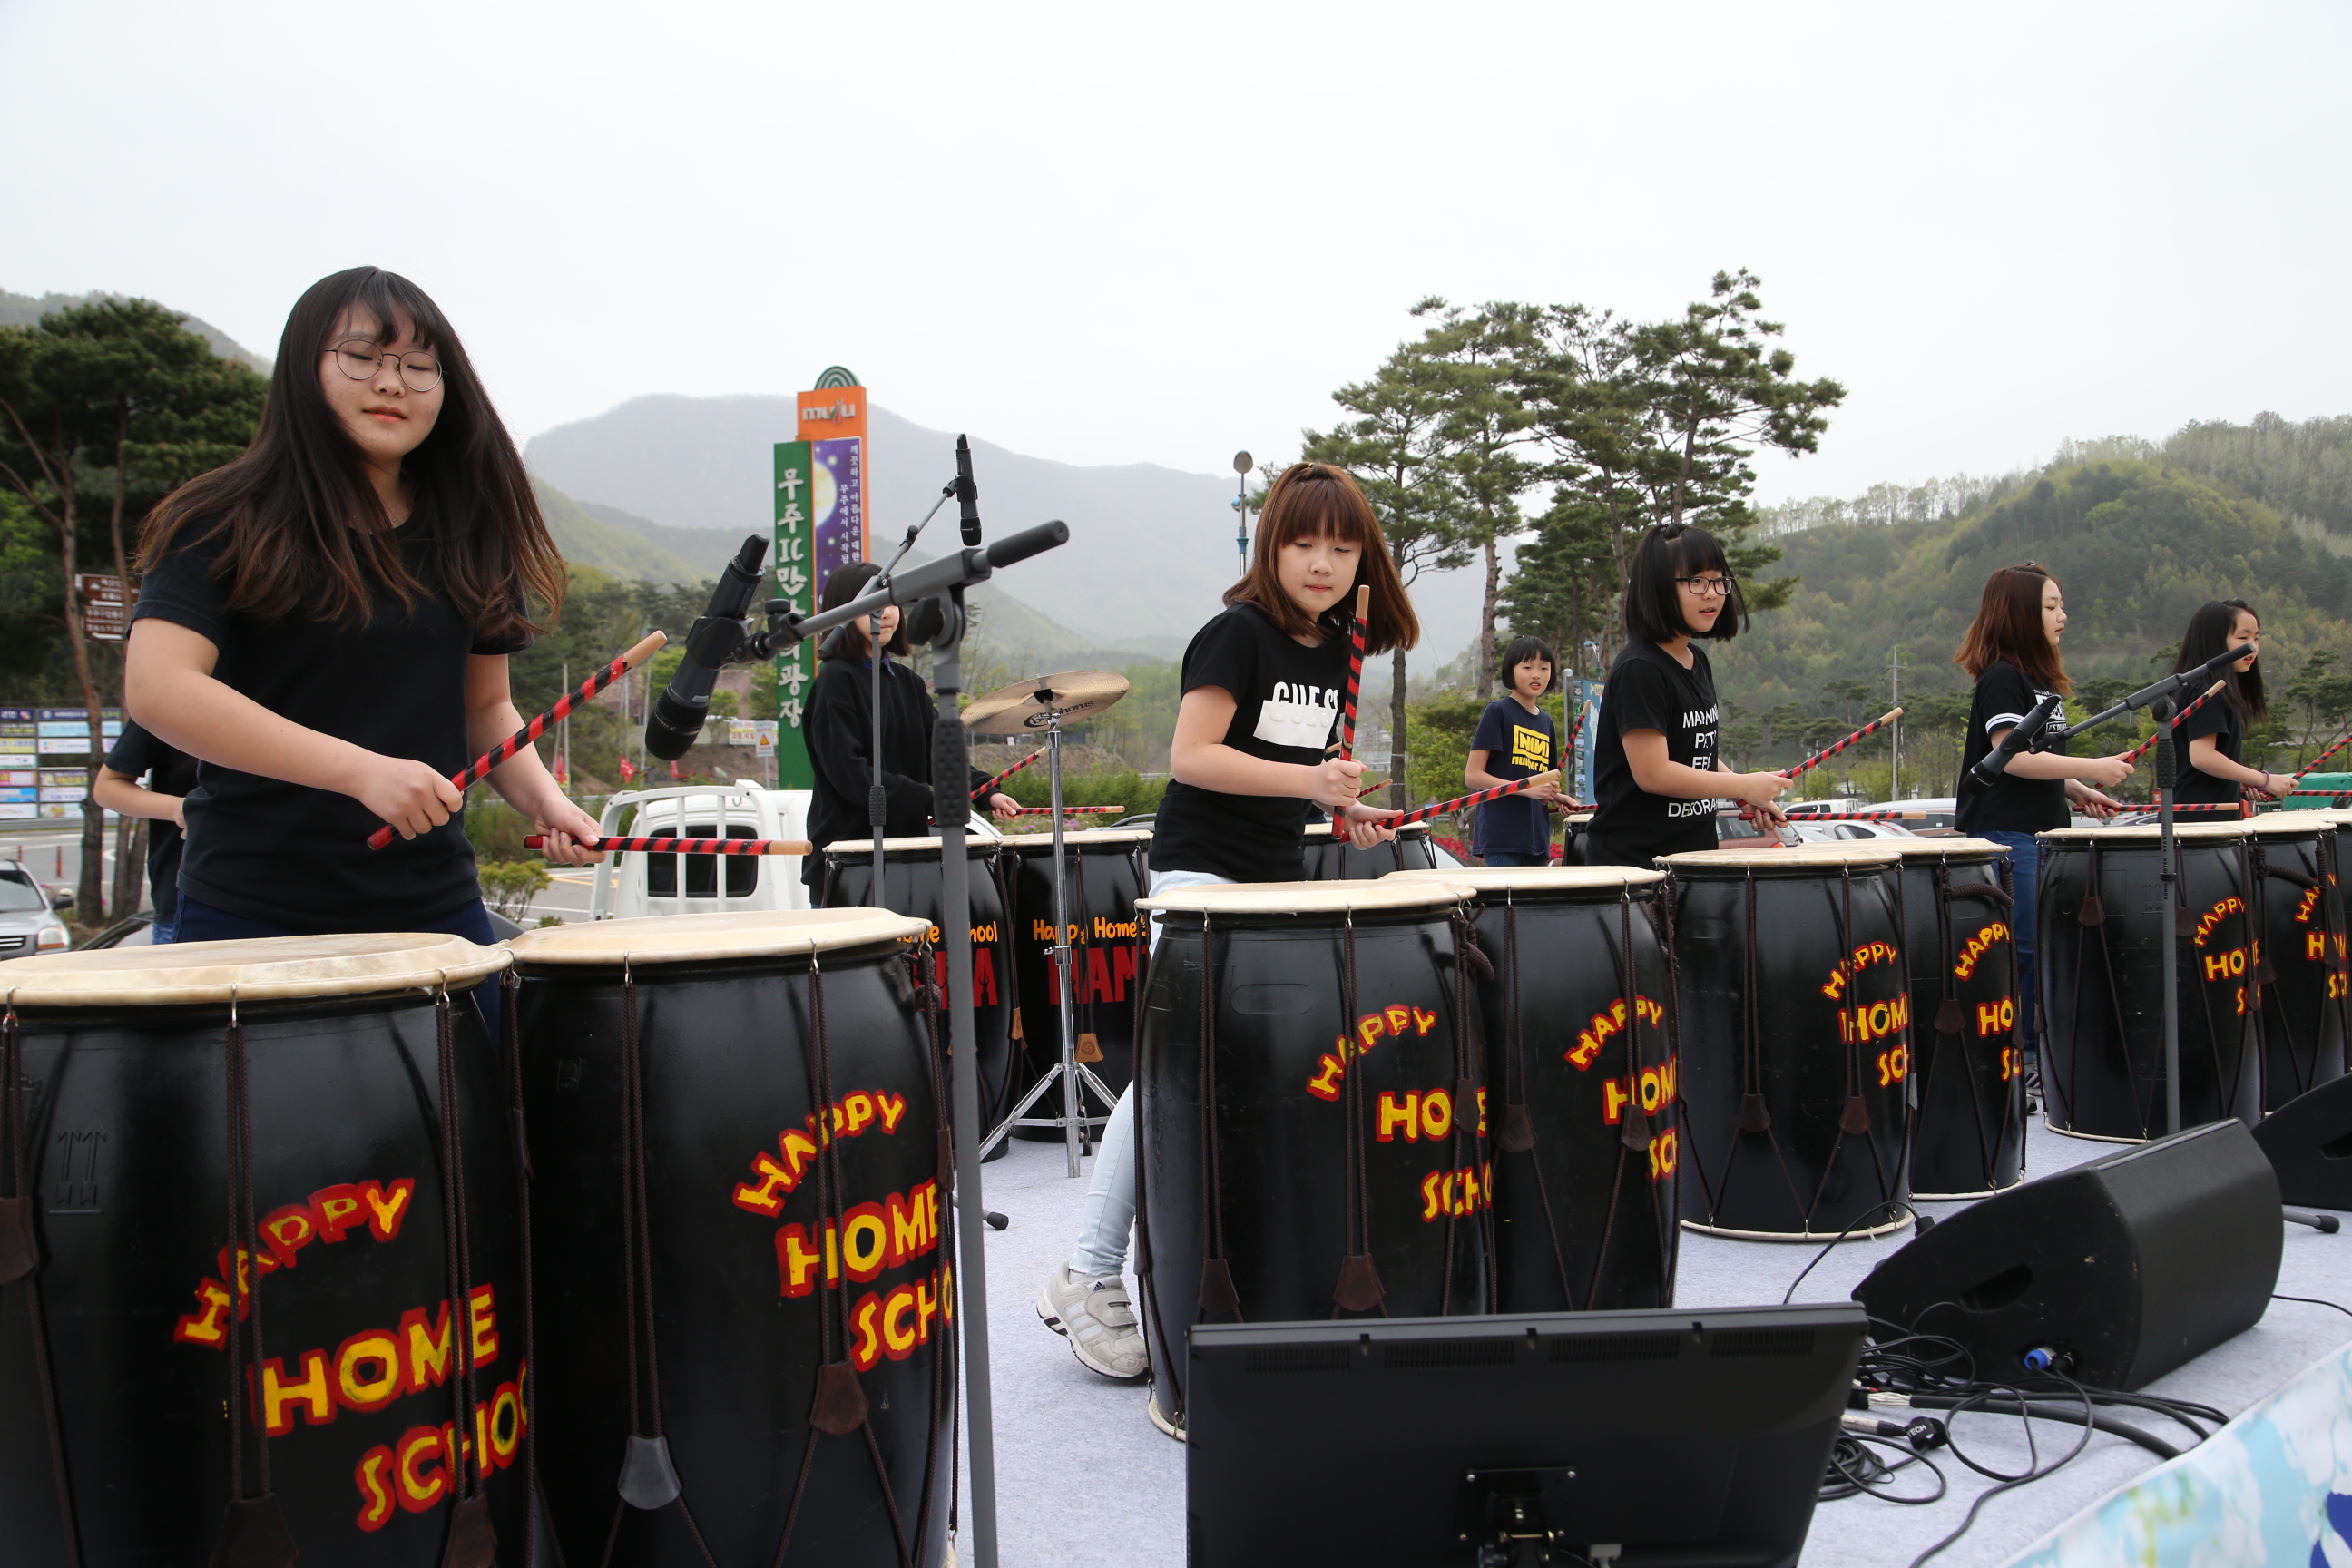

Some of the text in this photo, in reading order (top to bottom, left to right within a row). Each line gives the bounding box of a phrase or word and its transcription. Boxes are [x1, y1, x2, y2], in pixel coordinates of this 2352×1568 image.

[849, 444, 859, 487] 깨끗하고
[839, 484, 848, 528] 무주에서
[849, 492, 860, 536] 아름다운
[2295, 873, 2337, 923] HAY
[1821, 941, 1896, 1001] HAPPY
[1307, 1004, 1436, 1101] HAPPY
[1563, 995, 1664, 1071] HAPPY
[1377, 1086, 1486, 1143] HOE
[733, 1089, 906, 1218] HAPPY
[173, 1178, 415, 1350] HAPPY
[775, 1177, 941, 1298] HOME
[248, 1283, 499, 1436] HOME
